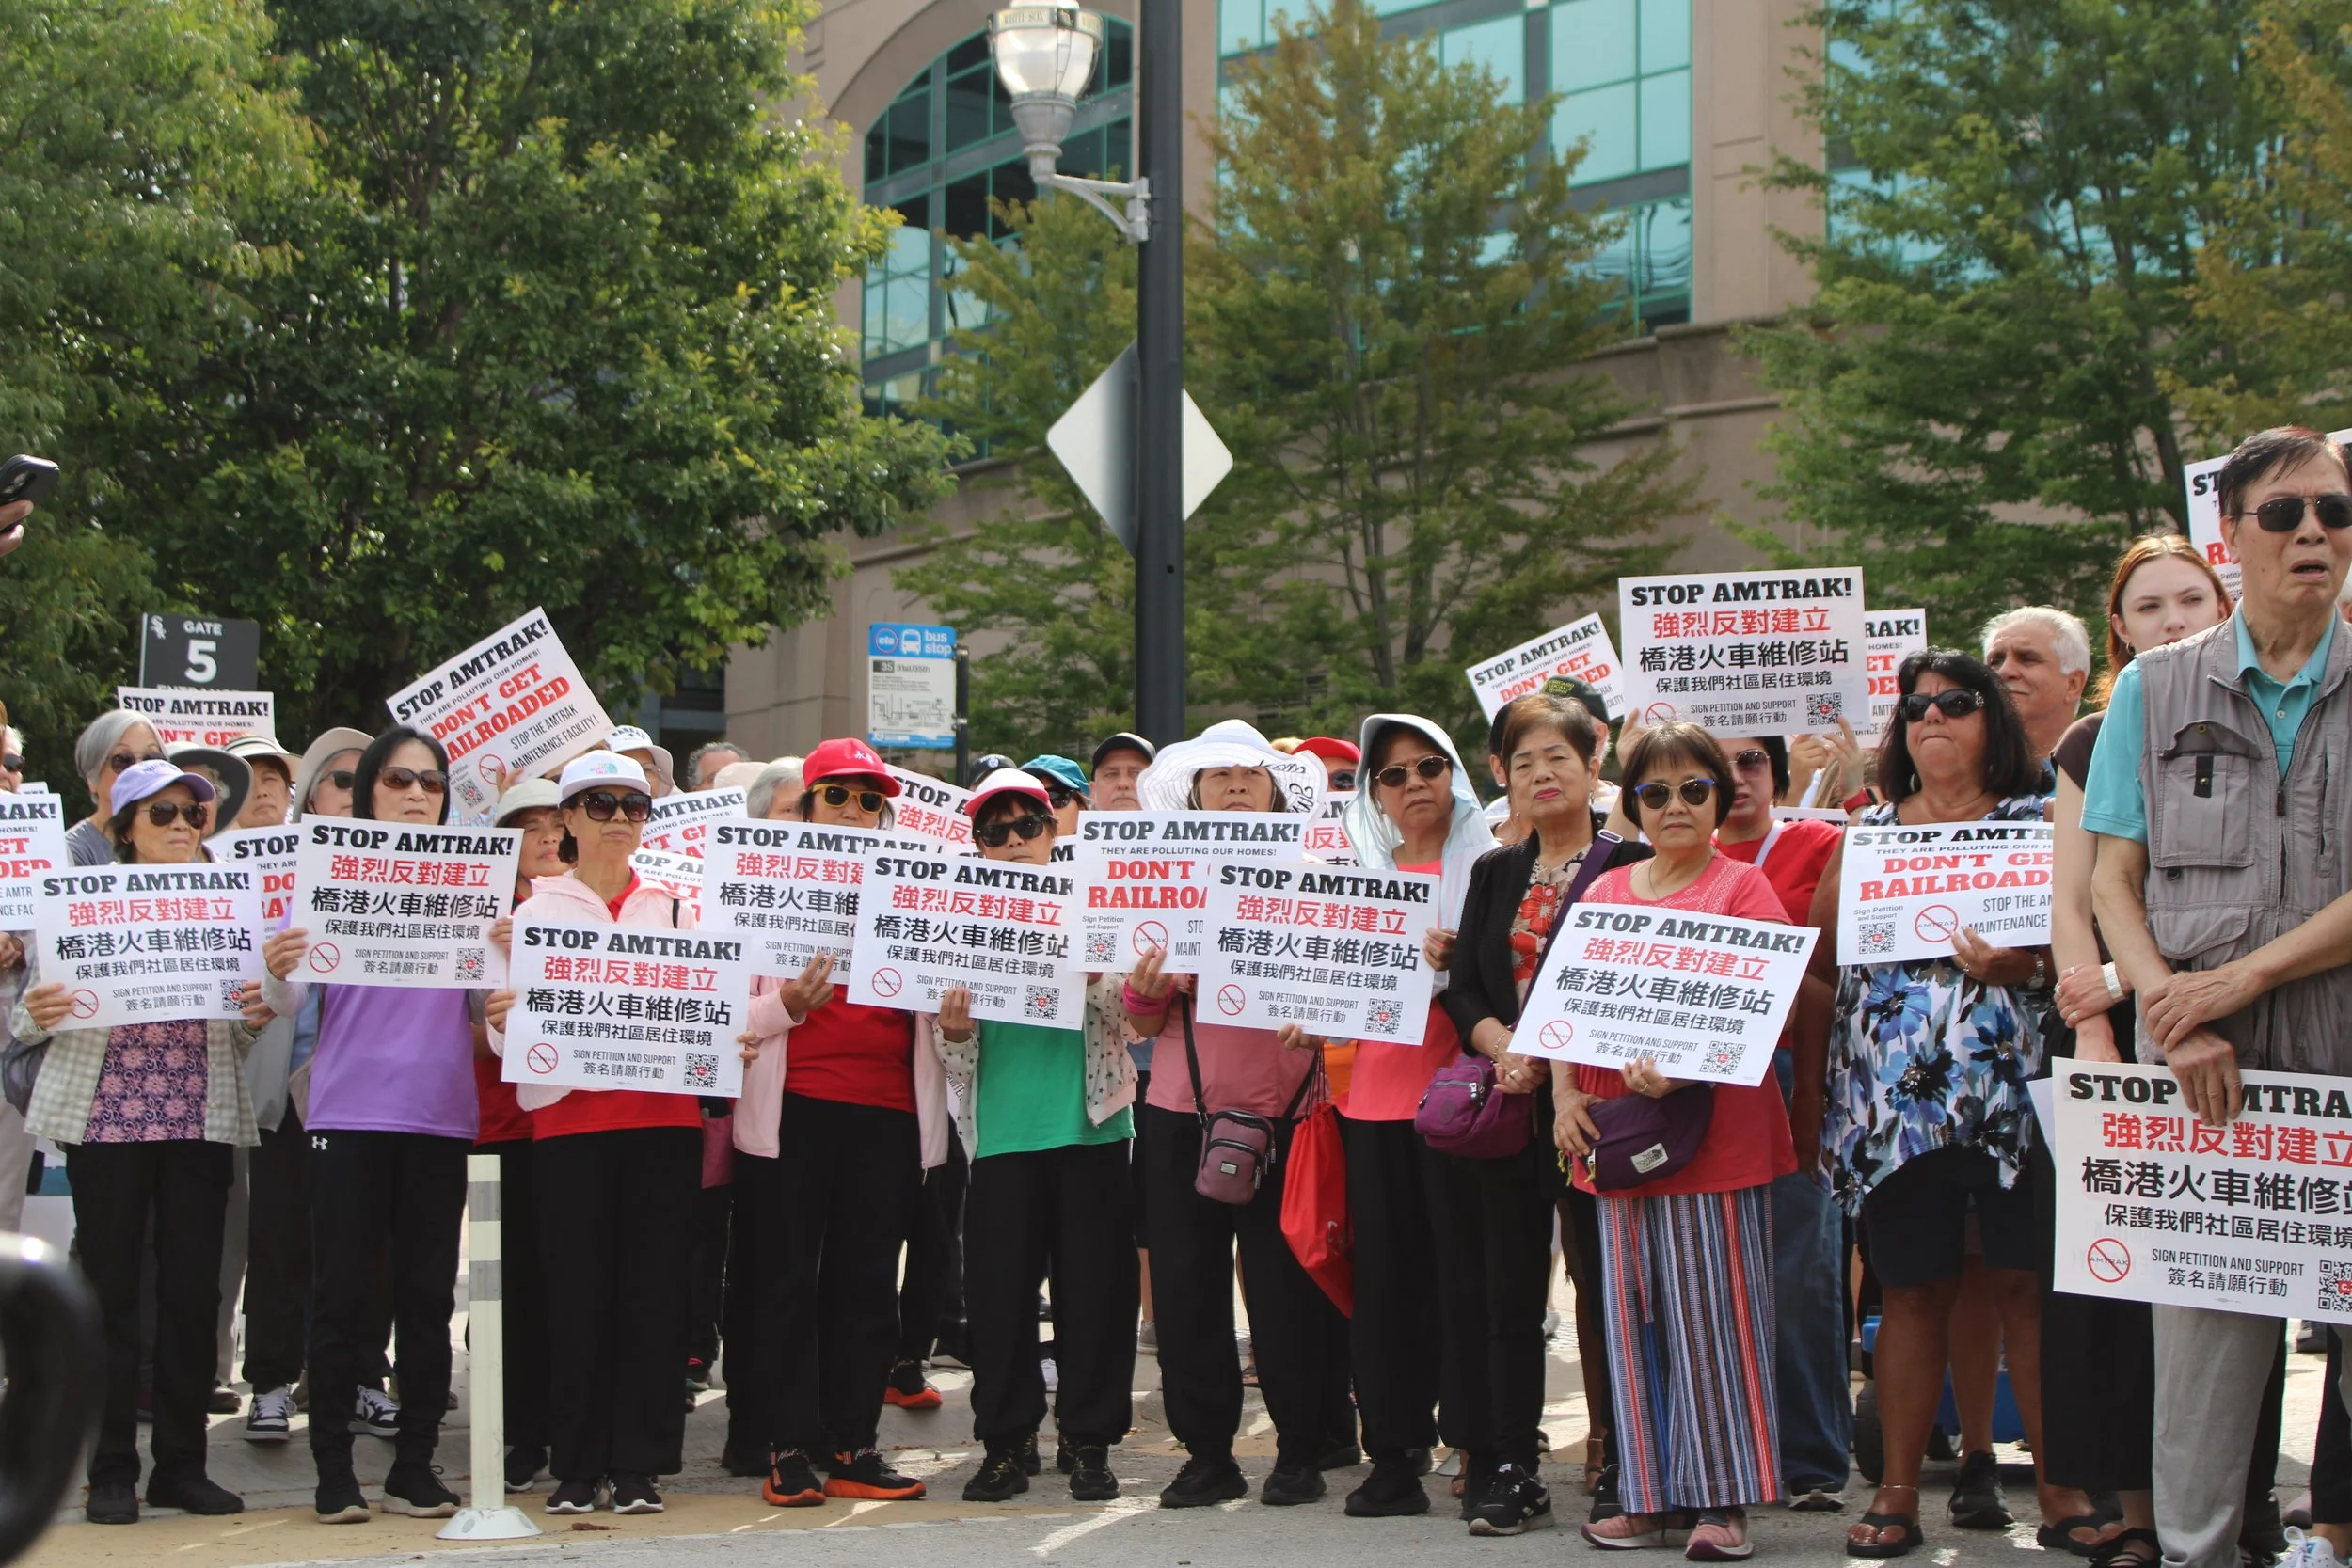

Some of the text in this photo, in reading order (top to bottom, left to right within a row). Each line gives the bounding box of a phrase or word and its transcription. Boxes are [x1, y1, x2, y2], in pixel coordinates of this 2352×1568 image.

[1631, 578, 1851, 606] STOP AMTRAK!
[183, 620, 223, 636] GATE
[925, 630, 947, 642] bus
[1653, 607, 1830, 639] 強烈反對建立
[184, 640, 217, 683] 5
[925, 643, 952, 656] stop
[1474, 621, 1601, 686] STOP AMTRAK!
[1640, 639, 1849, 673] 橋港火車維修站
[395, 618, 548, 721] STOP AMTRAK!
[1500, 671, 1549, 702] DON'T
[1557, 652, 1592, 675] GET
[1520, 659, 1553, 676] POLLUTING
[1554, 653, 1567, 661] OUR
[420, 648, 541, 725] THEY ARE POLLUTING OUR HOMES!
[1656, 671, 1833, 693] 保護我們社區居住環境
[123, 696, 269, 716] STOP AMTRAK!
[430, 663, 543, 740] DON'T GET
[1691, 700, 1796, 713] SIGN PETITION AND SUPPORT
[448, 676, 571, 765] AILROADED
[511, 704, 579, 750] STOP THE AMTRAK
[511, 715, 599, 769] MAINTENANCE FACILITY!
[680, 816, 697, 825] OUR
[1084, 821, 1155, 841] STOP
[1162, 821, 1301, 842] AMTRAK!
[234, 834, 299, 859] STOP
[312, 825, 514, 855] STOP AMTRAK!
[717, 826, 789, 847] STOP
[1852, 831, 1942, 846] STOP
[1152, 847, 1209, 855] POLLUTING
[1213, 847, 1235, 856] OUR
[1883, 854, 1992, 873] DON'T
[330, 854, 491, 887] 強烈反對建立
[875, 857, 947, 881] STOP
[1107, 860, 1196, 879] DON'T
[1220, 864, 1430, 903] STOP AMTRAK!
[44, 876, 117, 896] STOP
[126, 872, 250, 892] AMTRAK!
[1860, 870, 2053, 902] RAILROAD
[68, 897, 235, 927] 強烈反對建立
[311, 886, 500, 919] 橋港火車維修站
[892, 884, 1063, 926] 強烈反對建立
[1236, 895, 1407, 935] 強烈反對建立
[1853, 908, 1871, 916] Sign
[1871, 912, 1897, 921] Support
[1983, 896, 2035, 913] STOP THE
[325, 919, 481, 940] 保護我們社區居住環境
[1082, 915, 1096, 925] Sign
[1574, 911, 1806, 955] STOP AMTRAK!
[1968, 914, 2048, 935] MAINTENANCE
[56, 927, 252, 960] 橋港火車維修站
[524, 927, 741, 961] STOP AMTRAK!
[765, 941, 816, 954] SIGN PETITION
[874, 914, 1069, 958] 橋港火車維修站
[1217, 927, 1420, 971] 橋港火車維修站
[75, 958, 240, 980] 保護我們社區居住環境
[355, 948, 449, 961] SIGN PETITION AND SUPPORT
[887, 945, 1055, 979] 保護我們社區居住環境
[1582, 937, 1771, 981] 強烈反對建立
[544, 956, 719, 991] 強烈反對建立
[916, 974, 1017, 995] SIGN PETITION AND SUPPORT
[1231, 959, 1398, 991] 保護我們社區居住環境
[113, 983, 213, 998] SIGN PETITION AND SUPPORT
[1259, 991, 1359, 1009] SIGN PETITION AND SUPPORT
[1556, 965, 1775, 1016] 橋港火車維修站
[526, 988, 732, 1026] 橋港火車維修站
[1564, 998, 1746, 1035] 保護我們社區居住環境
[541, 1020, 713, 1046] 保護我們社區居住環境
[1589, 1030, 1699, 1052] SIGN PETITION AND SUPPORT
[573, 1050, 676, 1066] SIGN PETITION AND SUPPORT
[2070, 1073, 2177, 1105] STOP
[2103, 1113, 2352, 1168] 強烈反對建立
[2152, 1248, 2305, 1275] SIGN PETITION AND SUPPORT
[2168, 1267, 2287, 1297] 簽名請願行動
